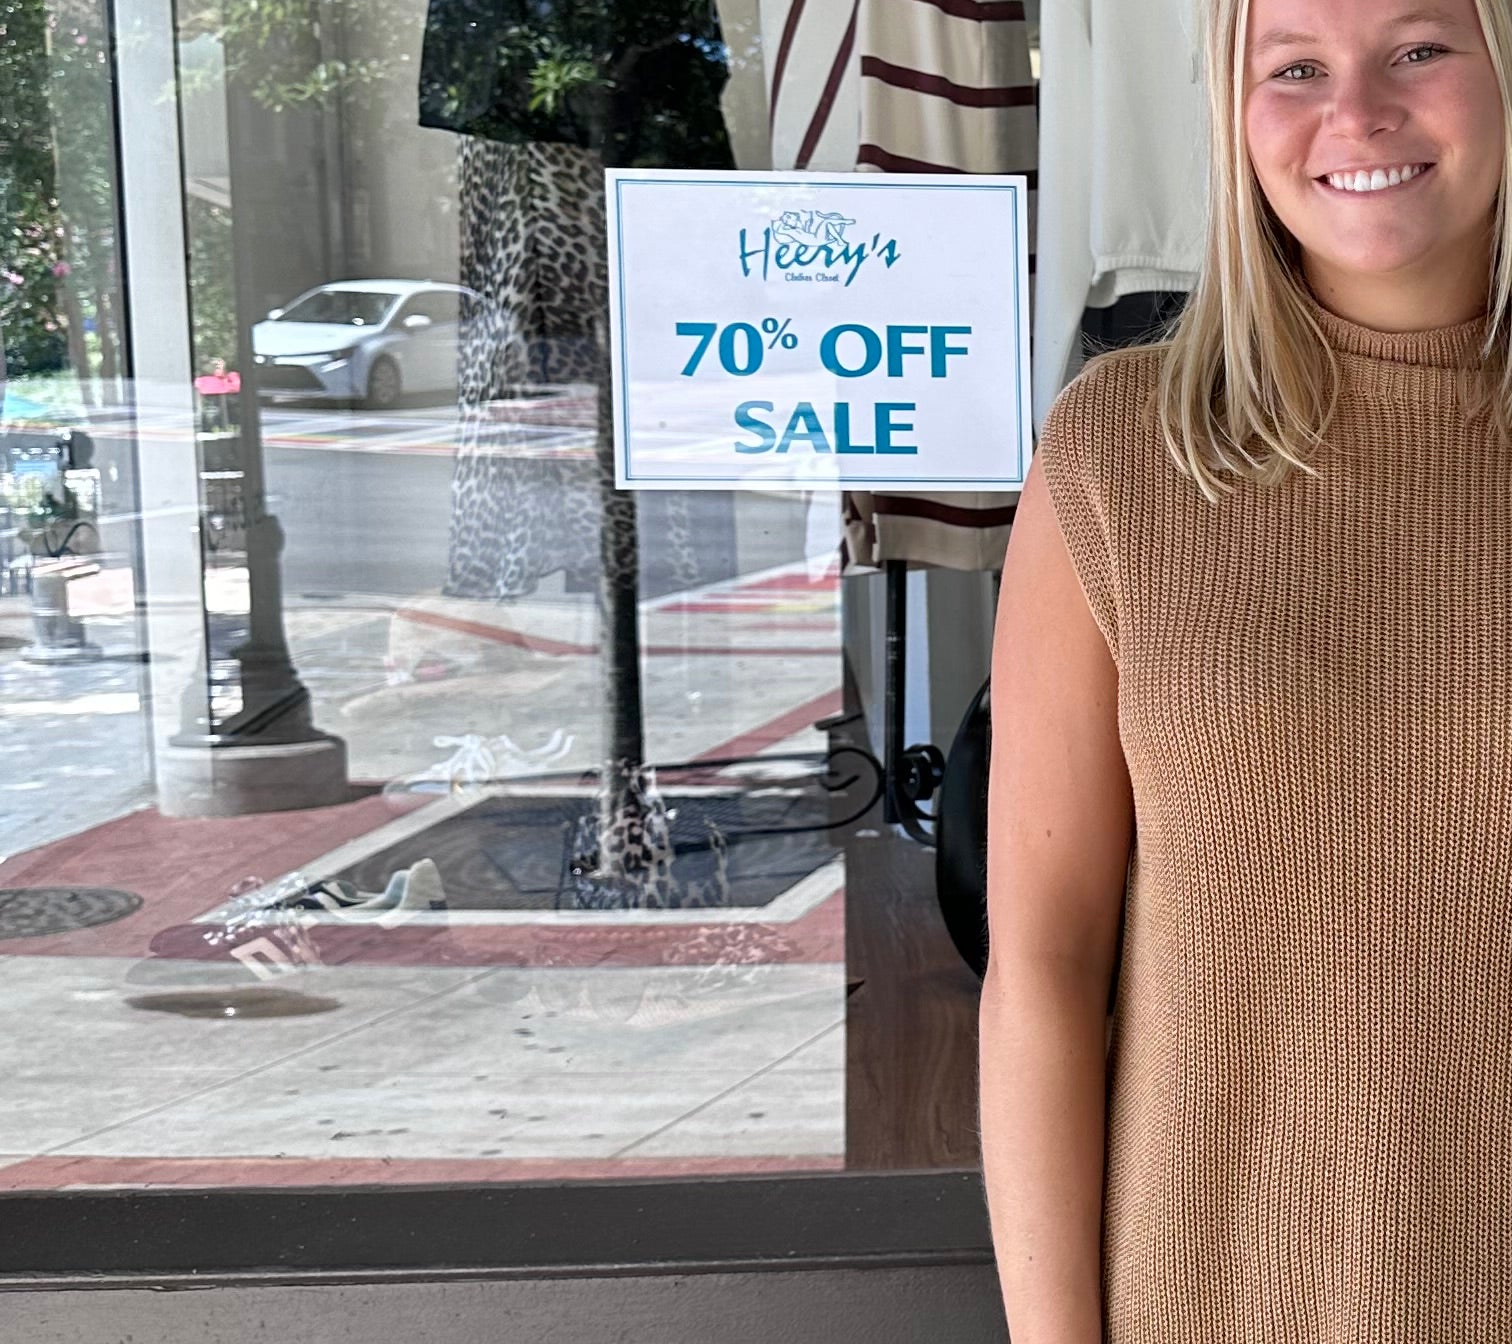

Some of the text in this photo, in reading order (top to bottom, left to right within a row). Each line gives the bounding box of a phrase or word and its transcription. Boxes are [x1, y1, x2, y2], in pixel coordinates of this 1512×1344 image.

[739, 228, 901, 287] Heery's
[675, 317, 972, 379] 70% OFF
[734, 400, 918, 455] SALE
